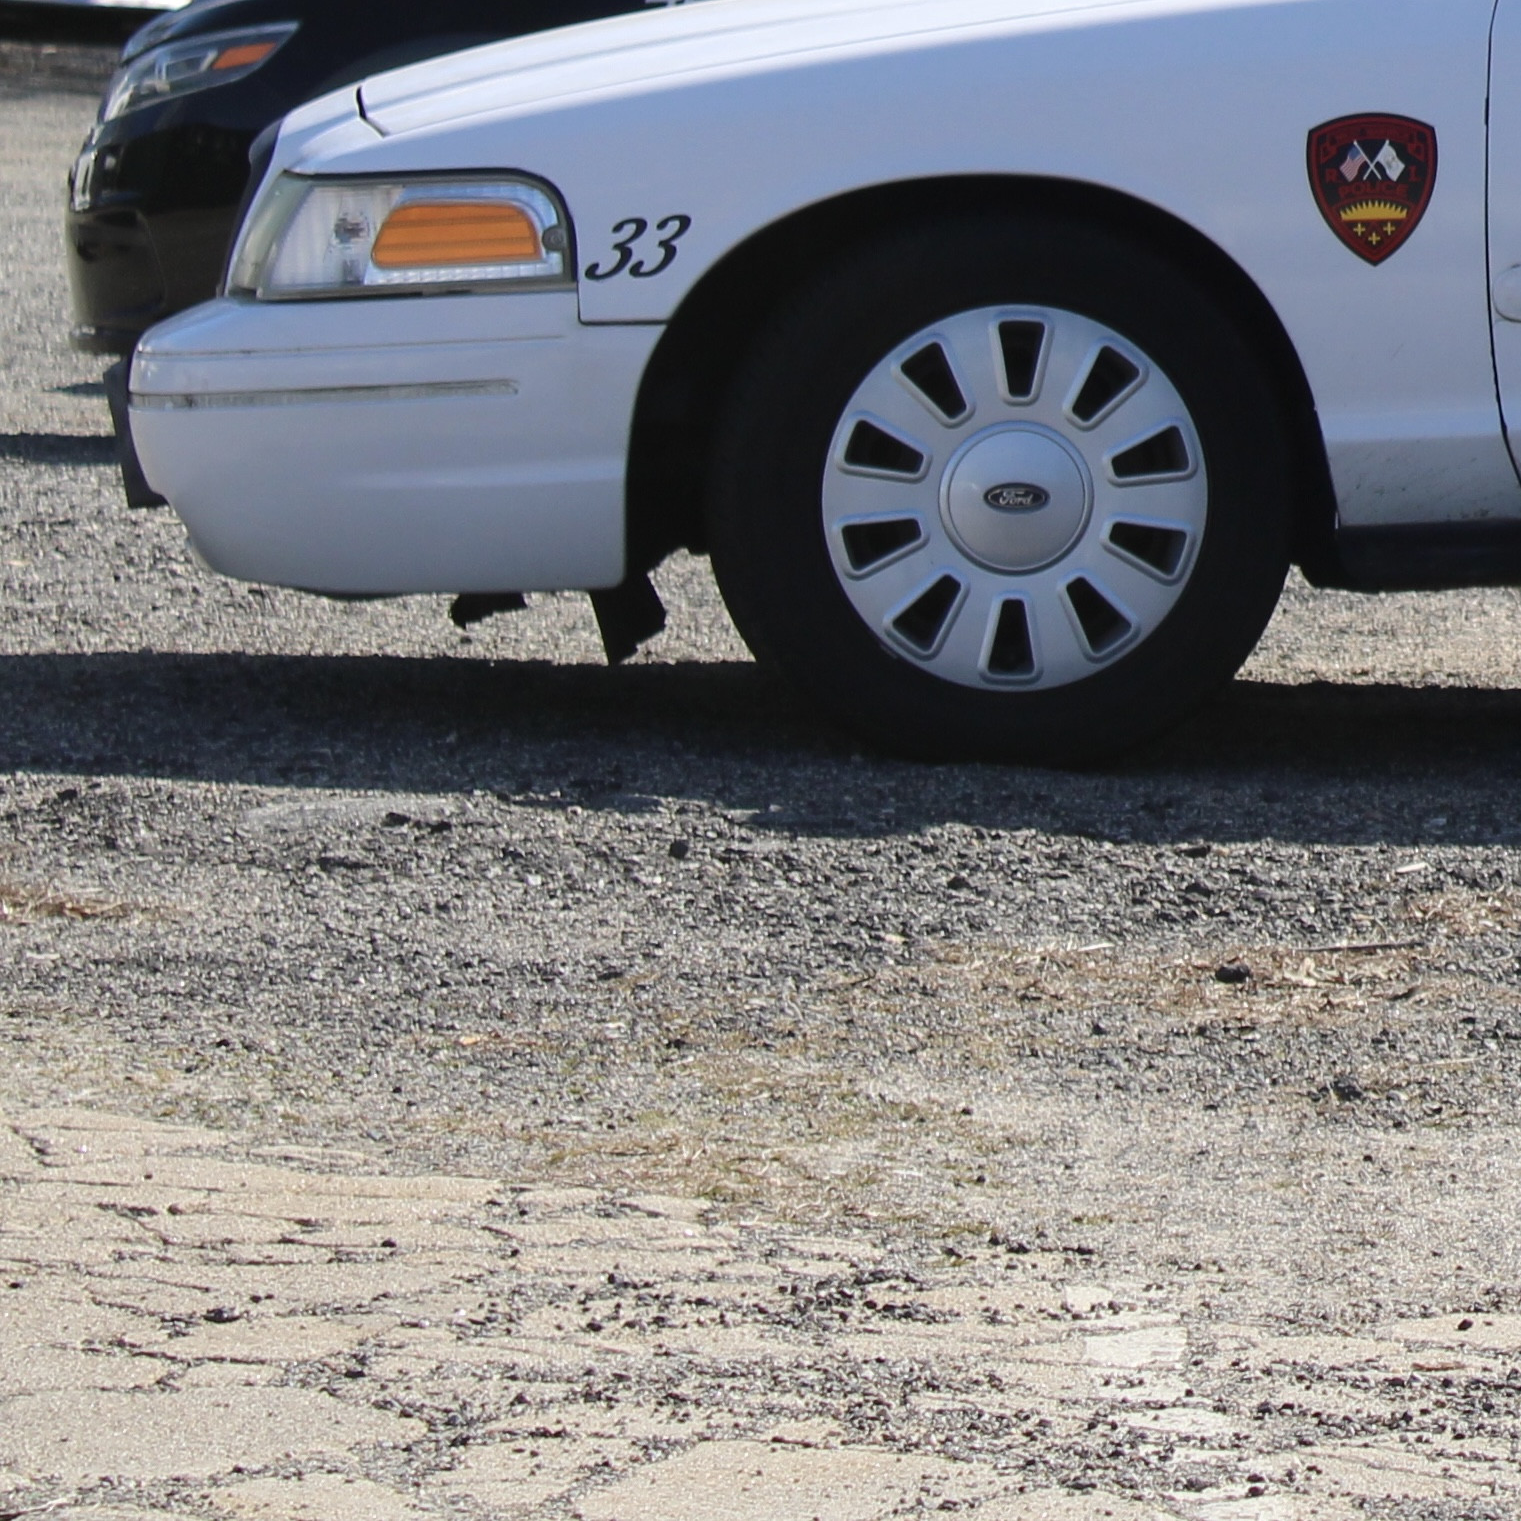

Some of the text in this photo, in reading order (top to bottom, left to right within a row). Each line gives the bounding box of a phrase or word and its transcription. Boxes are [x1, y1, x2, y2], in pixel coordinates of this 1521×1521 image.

[1337, 180, 1409, 198] POLICE
[584, 213, 692, 282] 33
[998, 487, 1034, 507] Ford
